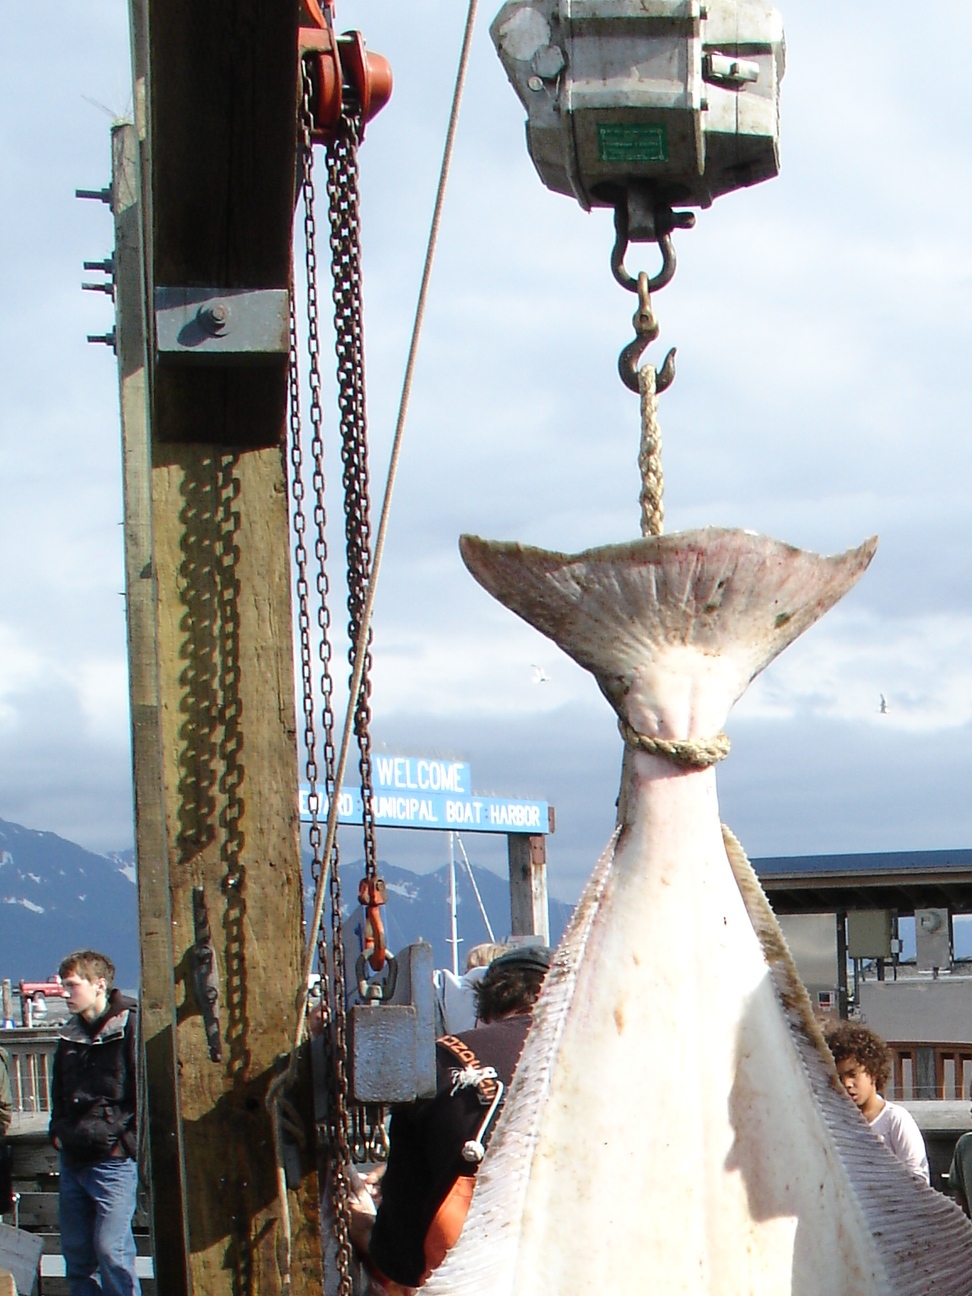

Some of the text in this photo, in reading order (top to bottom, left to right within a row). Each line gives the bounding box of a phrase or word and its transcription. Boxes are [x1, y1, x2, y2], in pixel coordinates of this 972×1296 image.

[376, 757, 465, 793] WELCOME
[366, 794, 438, 822] UNICIPAL
[446, 800, 483, 824] BOAT
[490, 804, 541, 827] HARBOR
